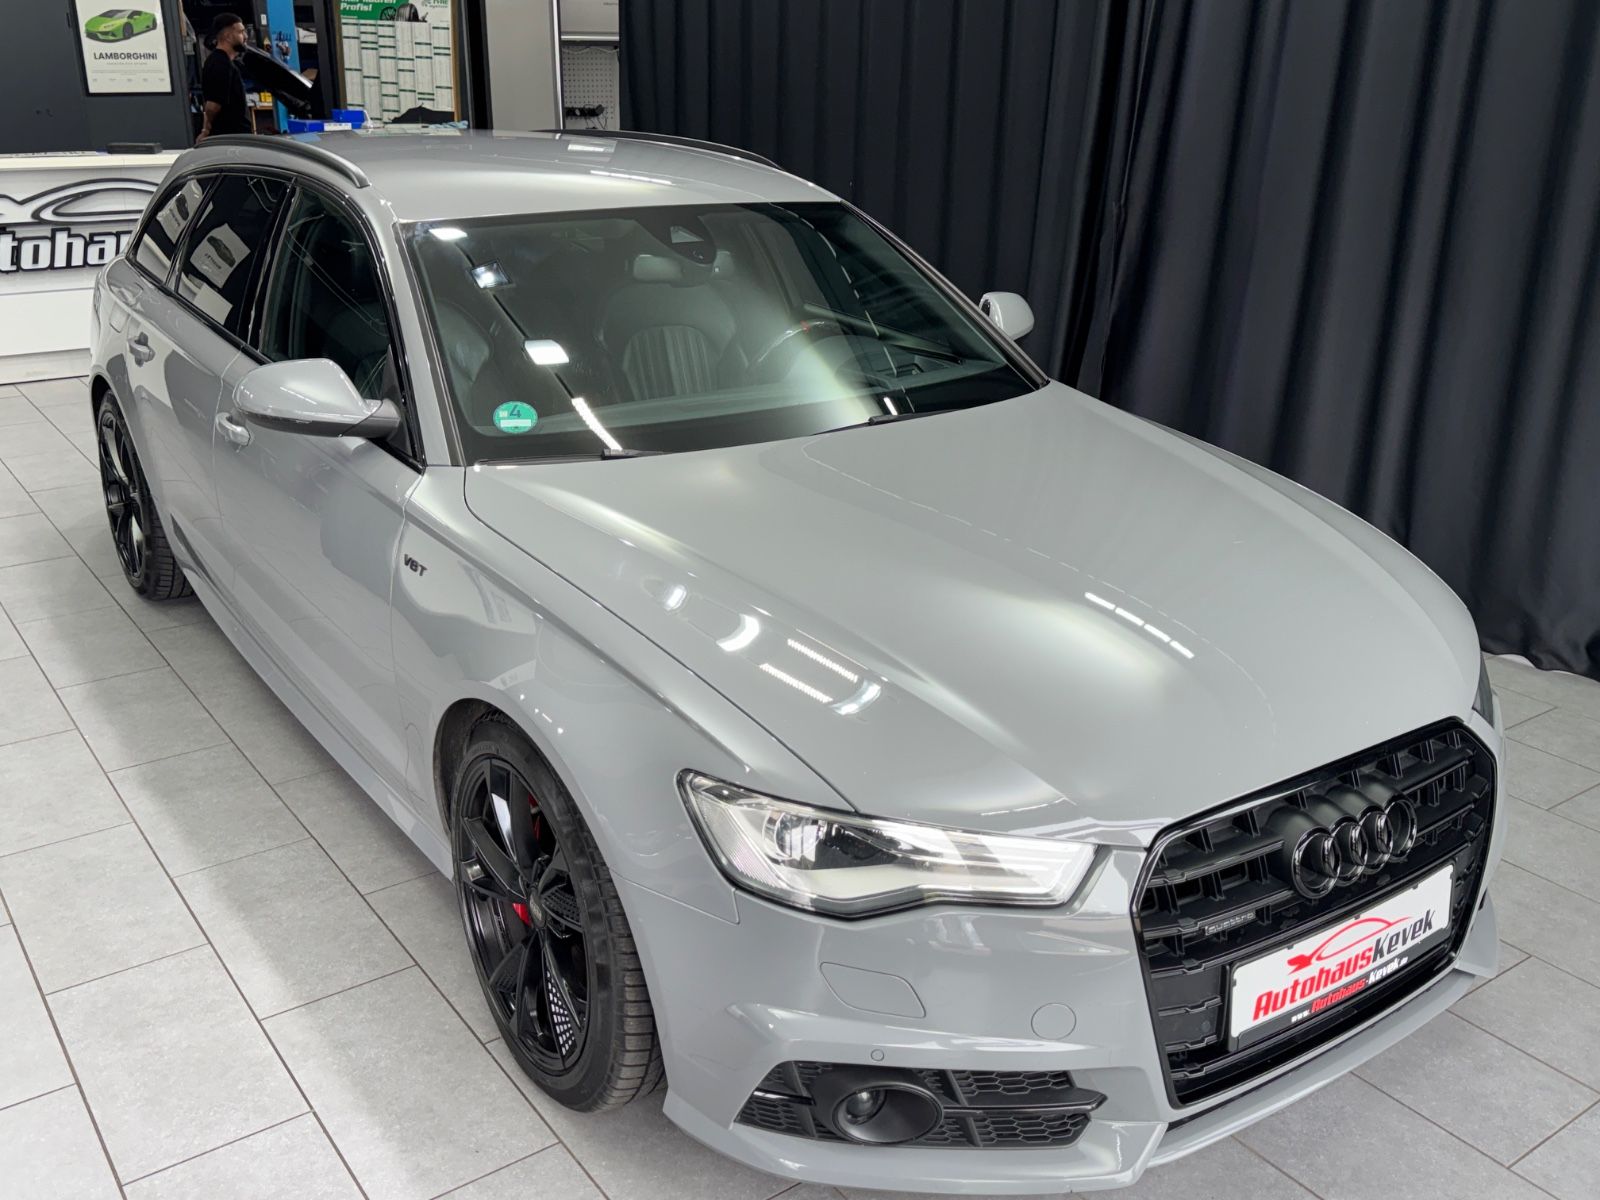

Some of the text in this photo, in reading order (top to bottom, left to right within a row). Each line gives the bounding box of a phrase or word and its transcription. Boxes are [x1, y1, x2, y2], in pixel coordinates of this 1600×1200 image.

[340, 3, 373, 11] Profis!
[93, 52, 158, 60] LAMBORGHINI
[509, 404, 522, 418] 4
